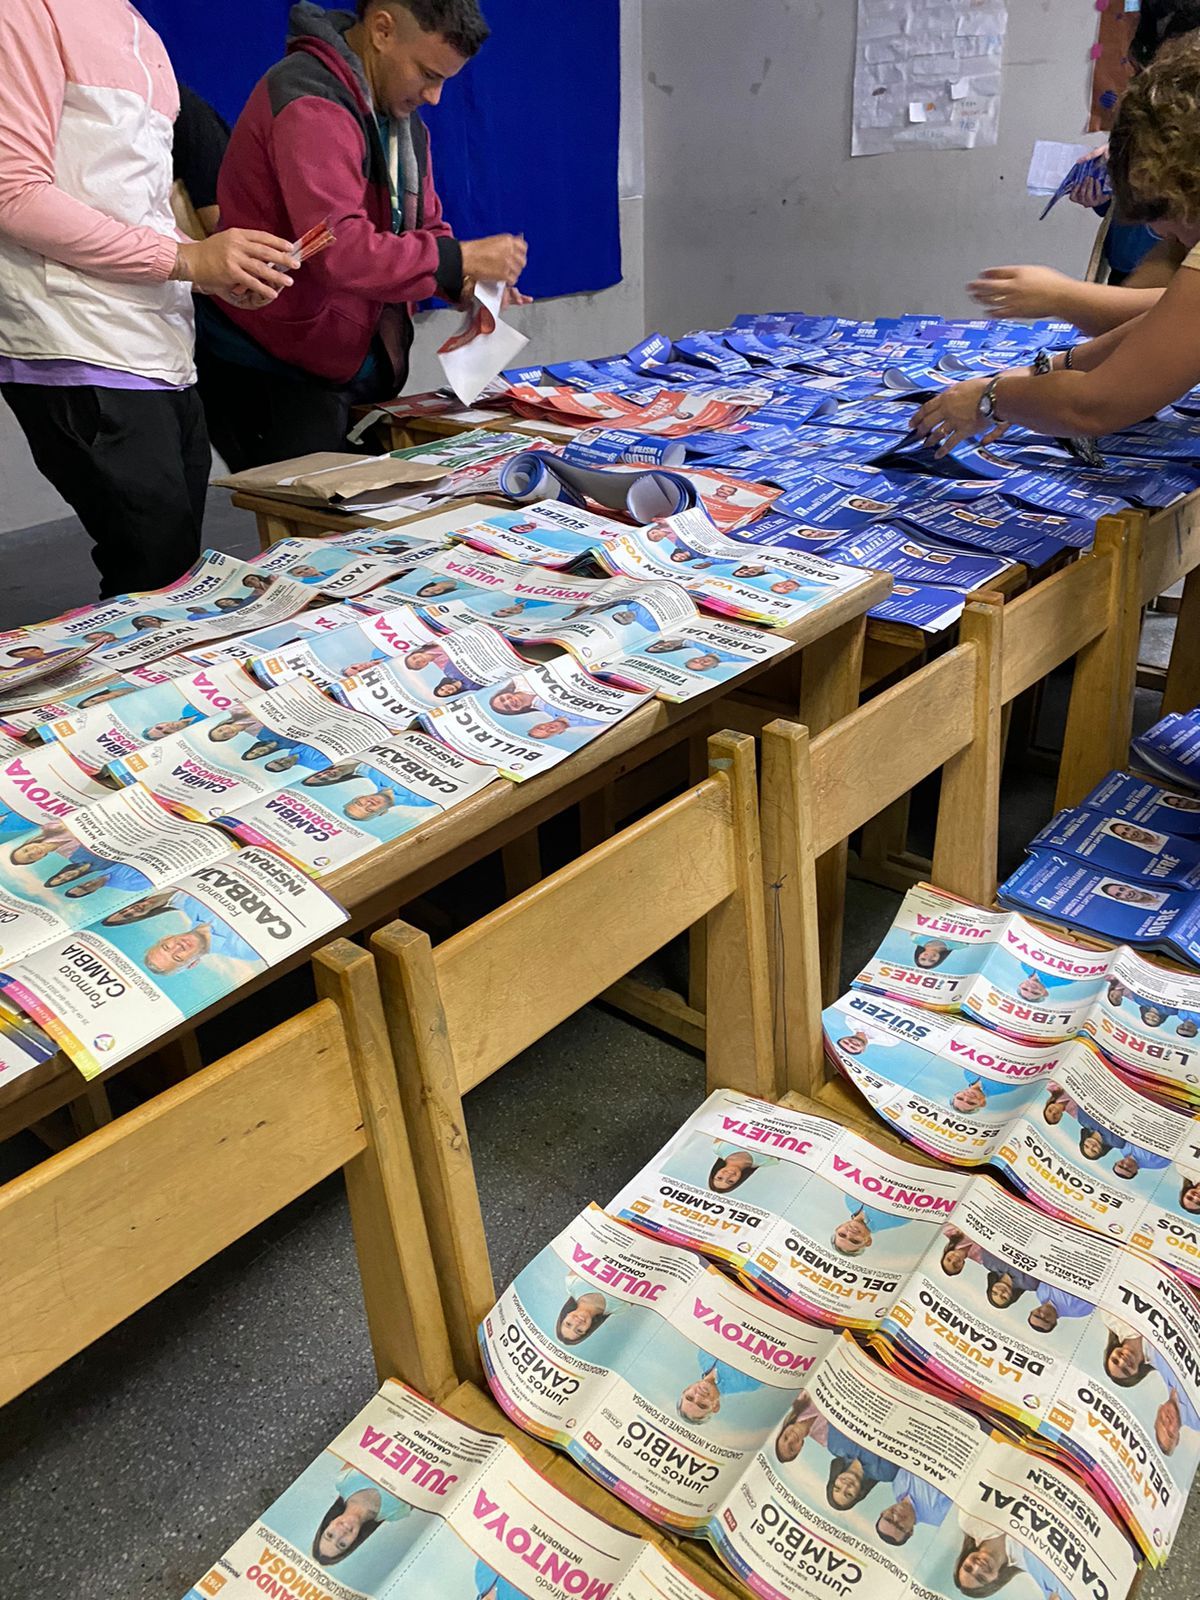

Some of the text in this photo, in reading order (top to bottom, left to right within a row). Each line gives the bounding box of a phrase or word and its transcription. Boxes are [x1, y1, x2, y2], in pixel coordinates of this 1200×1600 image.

[497, 533, 526, 546] CON
[446, 560, 504, 586] JULIETA
[643, 563, 675, 580] CON
[755, 553, 840, 582] CARBAJAL
[513, 582, 592, 602] MONTOYA
[735, 588, 769, 604] CON
[770, 597, 792, 609] ES
[101, 625, 199, 661] CARBAJAL
[286, 657, 332, 690] RICH
[361, 670, 419, 719] LRICH
[446, 698, 543, 762] BULLRICH
[404, 735, 464, 769] INSFRAN
[171, 765, 227, 793] CAMBIA
[182, 759, 240, 788] FORMOSA
[73, 816, 97, 841] NATALIA
[80, 811, 105, 838] ALARIO
[265, 799, 330, 842] CAMBIA
[276, 794, 342, 836] FORMOSA
[238, 851, 306, 897] INSFRAN
[196, 883, 242, 918] Fernando
[916, 913, 991, 938] JULIETA
[61, 943, 125, 997] CAMBIA
[1007, 930, 1109, 975] MONTOYA
[58, 965, 106, 1009] Formosa
[887, 1025, 920, 1042] DANIEL
[950, 1040, 1058, 1076] MONTOYA
[864, 1075, 884, 1088] ES
[722, 1116, 813, 1155] JULIETA
[749, 1120, 791, 1136] GONZALEZ
[906, 1100, 1000, 1138] ES CON VOS
[911, 1113, 967, 1143] CAMBIO
[832, 1154, 957, 1213] MONTOYA
[878, 1175, 925, 1193] INTENDENTE
[1025, 1135, 1123, 1209] ES CON VOS
[1027, 1155, 1109, 1214] EL CAMBIO
[659, 1186, 761, 1228] DEL CAMBIO
[661, 1199, 741, 1234] LA FUERZA
[891, 1202, 950, 1219] Miguel Alfredo
[967, 1213, 995, 1236] ALARIO
[965, 1218, 992, 1240] NATALIA
[1157, 1218, 1198, 1244] VOS
[572, 1243, 667, 1301] JULIETA
[602, 1255, 646, 1278] GONZALEZ
[618, 1253, 654, 1271] CABALLERO
[785, 1237, 898, 1293] DEL CAMBIO
[1001, 1245, 1037, 1268] COSTA
[1012, 1259, 1032, 1272] ANA
[1044, 1262, 1095, 1287] AMARILLA
[790, 1256, 878, 1303] LA FUERZA
[1157, 1280, 1200, 1339] SFRAN
[693, 1297, 816, 1371] MONTOYA
[741, 1321, 787, 1348] INTENDENTE
[919, 1290, 1045, 1377] DEL CAMBIO
[925, 1313, 1023, 1383] LA FUERZA
[1118, 1285, 1200, 1387] ARBAJAL
[499, 1334, 569, 1406] Juntos por el
[507, 1324, 580, 1394] CAMBIO
[750, 1355, 780, 1372] Alfredo
[1152, 1330, 1187, 1380] Fernando
[817, 1374, 834, 1400] ALARIO
[632, 1394, 744, 1460] CANDIDATO INTENDENTE DE FORMOSA
[815, 1387, 874, 1441] ANKENBRAND
[841, 1406, 869, 1427] NATALIA
[360, 1425, 458, 1496] JULIETA
[393, 1431, 439, 1464] GONZALEZ
[414, 1430, 452, 1456] CABALLERO
[628, 1421, 719, 1481] CAMBIO
[873, 1427, 958, 1479] JUAN CARLOS AMARILLA
[876, 1439, 909, 1460] COSTA
[1077, 1388, 1170, 1508] DEL CAMBIO
[1087, 1411, 1157, 1510] LA FUERZA
[617, 1436, 709, 1494] Juntos por el
[923, 1464, 946, 1481] ANA
[756, 1453, 909, 1584] CANDIDATOS/AS DIPUTADOS/AS PROVINCIALES TITULARES
[1027, 1469, 1101, 1538] INSFRAN
[977, 1481, 1109, 1600] CARBAJAL
[1022, 1494, 1086, 1553] GOBERNADOR
[472, 1488, 614, 1600] MONTOYA
[530, 1523, 583, 1564] INTENDENTE
[750, 1519, 852, 1597] Juntos por el
[761, 1503, 862, 1584] CAMBIO
[1009, 1519, 1074, 1581] FERNANDO
[246, 1565, 298, 1600] ANDO
[535, 1575, 569, 1600] Alfredo
